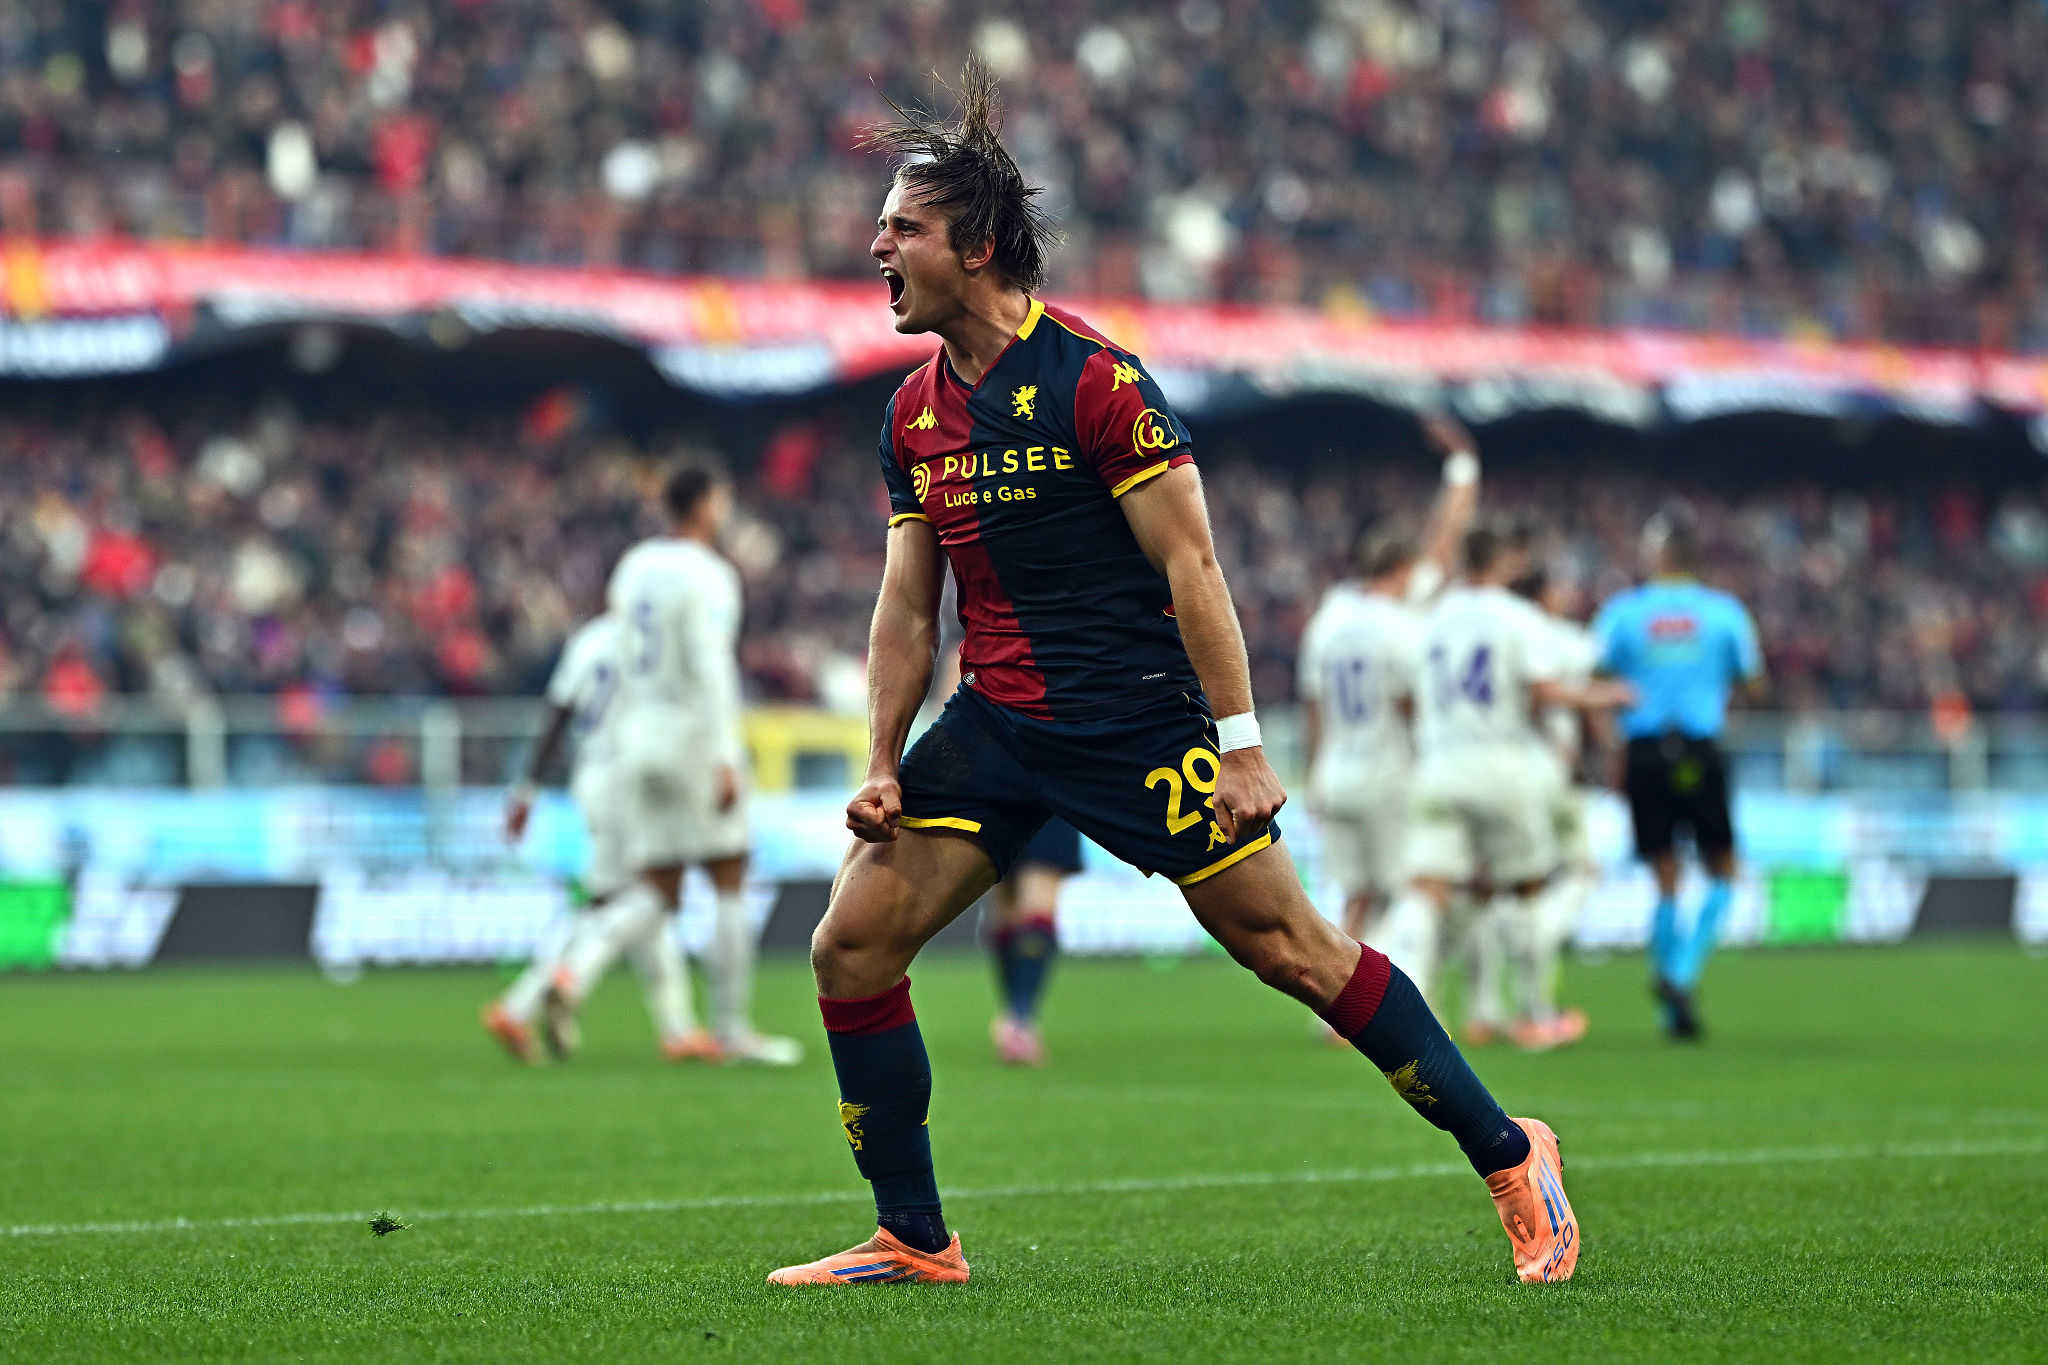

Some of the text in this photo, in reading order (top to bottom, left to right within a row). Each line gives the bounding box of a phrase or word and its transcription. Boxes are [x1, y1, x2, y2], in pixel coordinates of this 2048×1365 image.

[942, 446, 1075, 481] PULSEE
[944, 486, 1037, 508] Luce e Gas
[1142, 671, 1167, 681] KOMBAT
[1430, 645, 1493, 714] 14
[1144, 747, 1221, 836] 29
